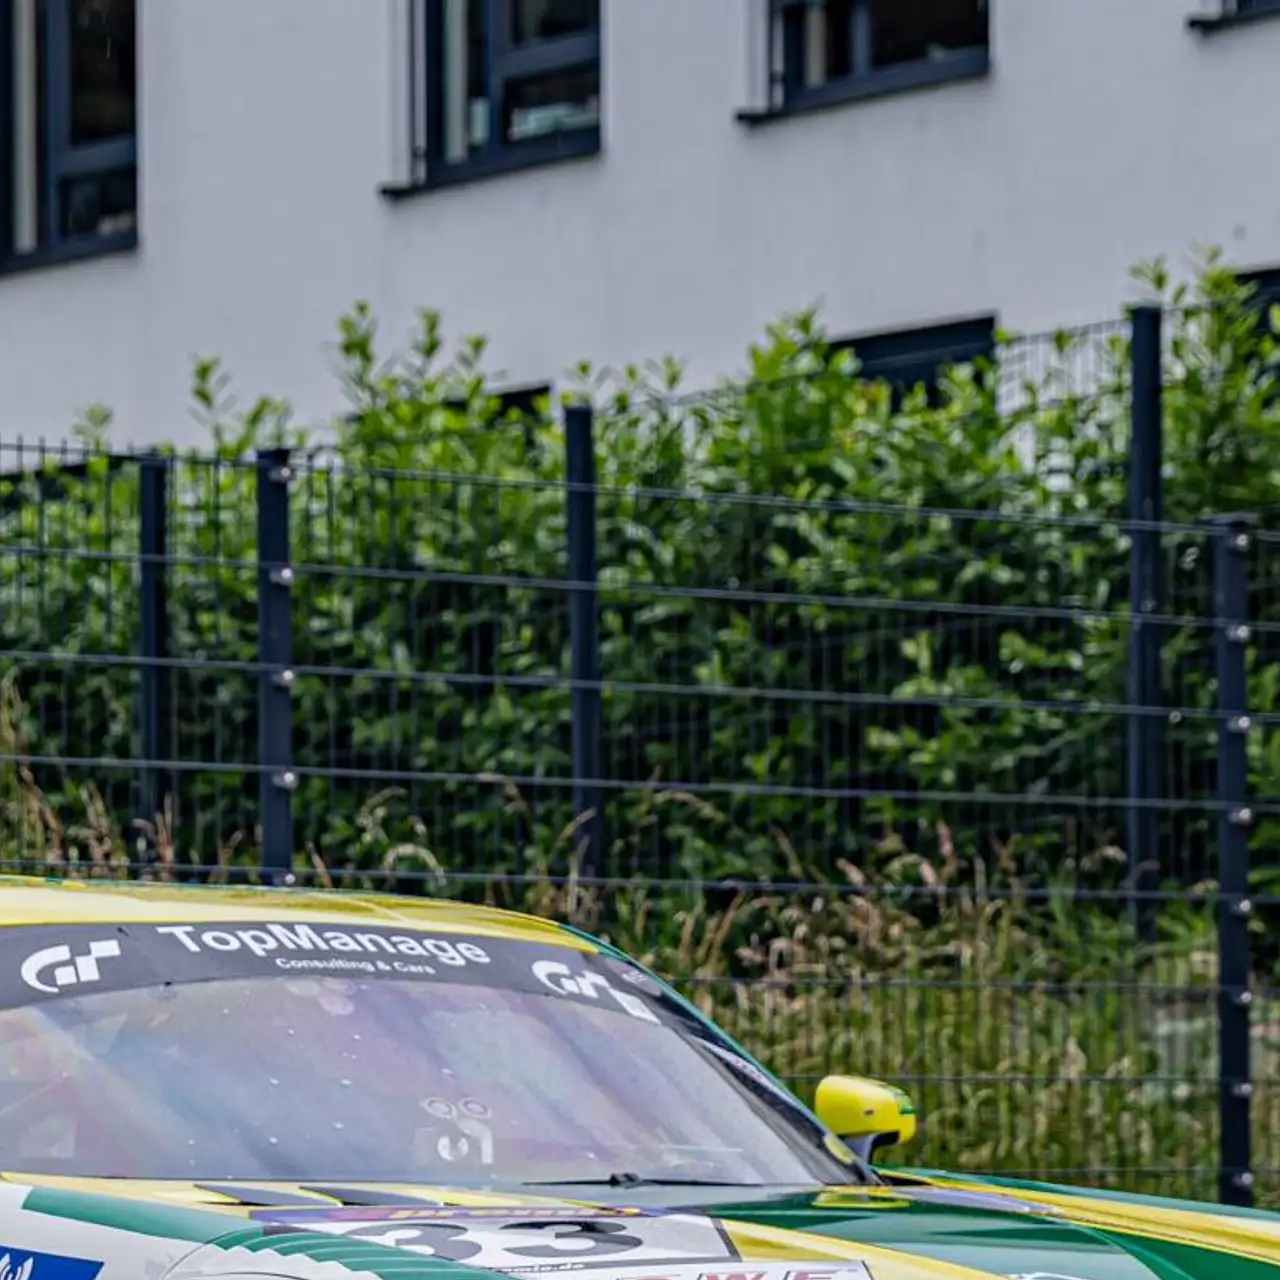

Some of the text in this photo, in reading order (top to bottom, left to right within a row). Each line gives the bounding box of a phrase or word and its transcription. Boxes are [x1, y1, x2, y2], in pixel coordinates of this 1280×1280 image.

[156, 923, 491, 967] TopManage
[275, 957, 438, 975] Consulting & Cars
[342, 1210, 644, 1261] 33
